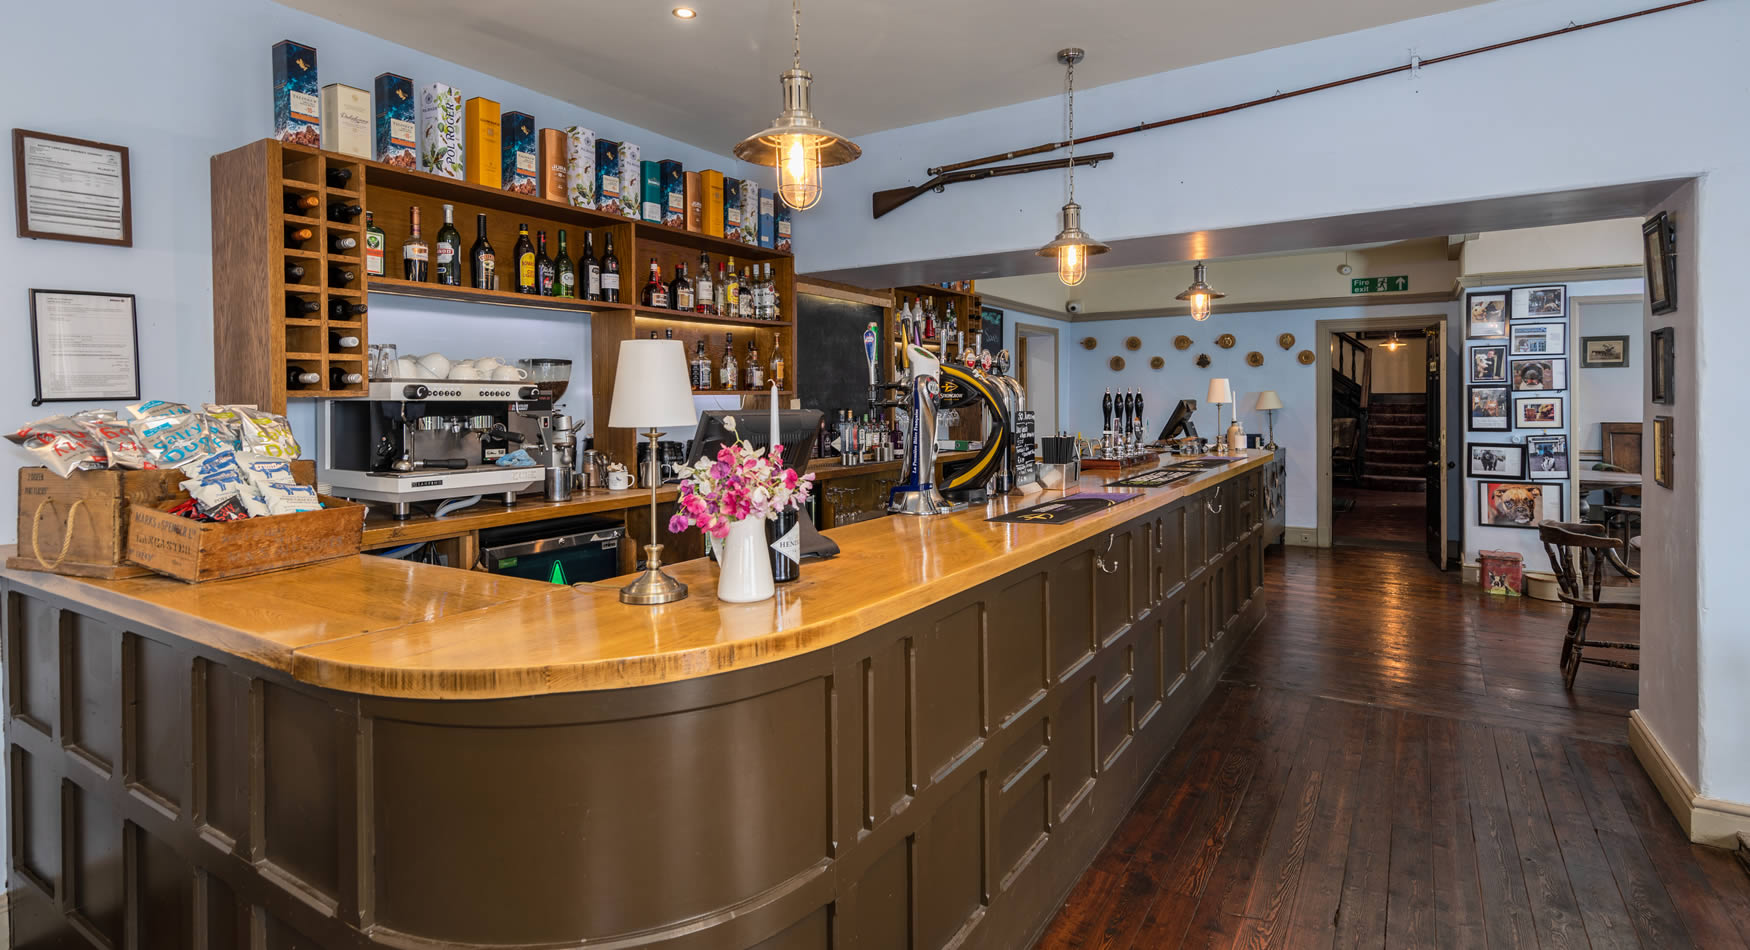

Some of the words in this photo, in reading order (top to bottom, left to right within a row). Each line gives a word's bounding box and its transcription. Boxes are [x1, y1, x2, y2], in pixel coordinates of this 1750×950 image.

[446, 102, 456, 141] ROGER
[446, 143, 456, 165] POL
[154, 424, 202, 455] Salty
[135, 512, 157, 528] MARKS
